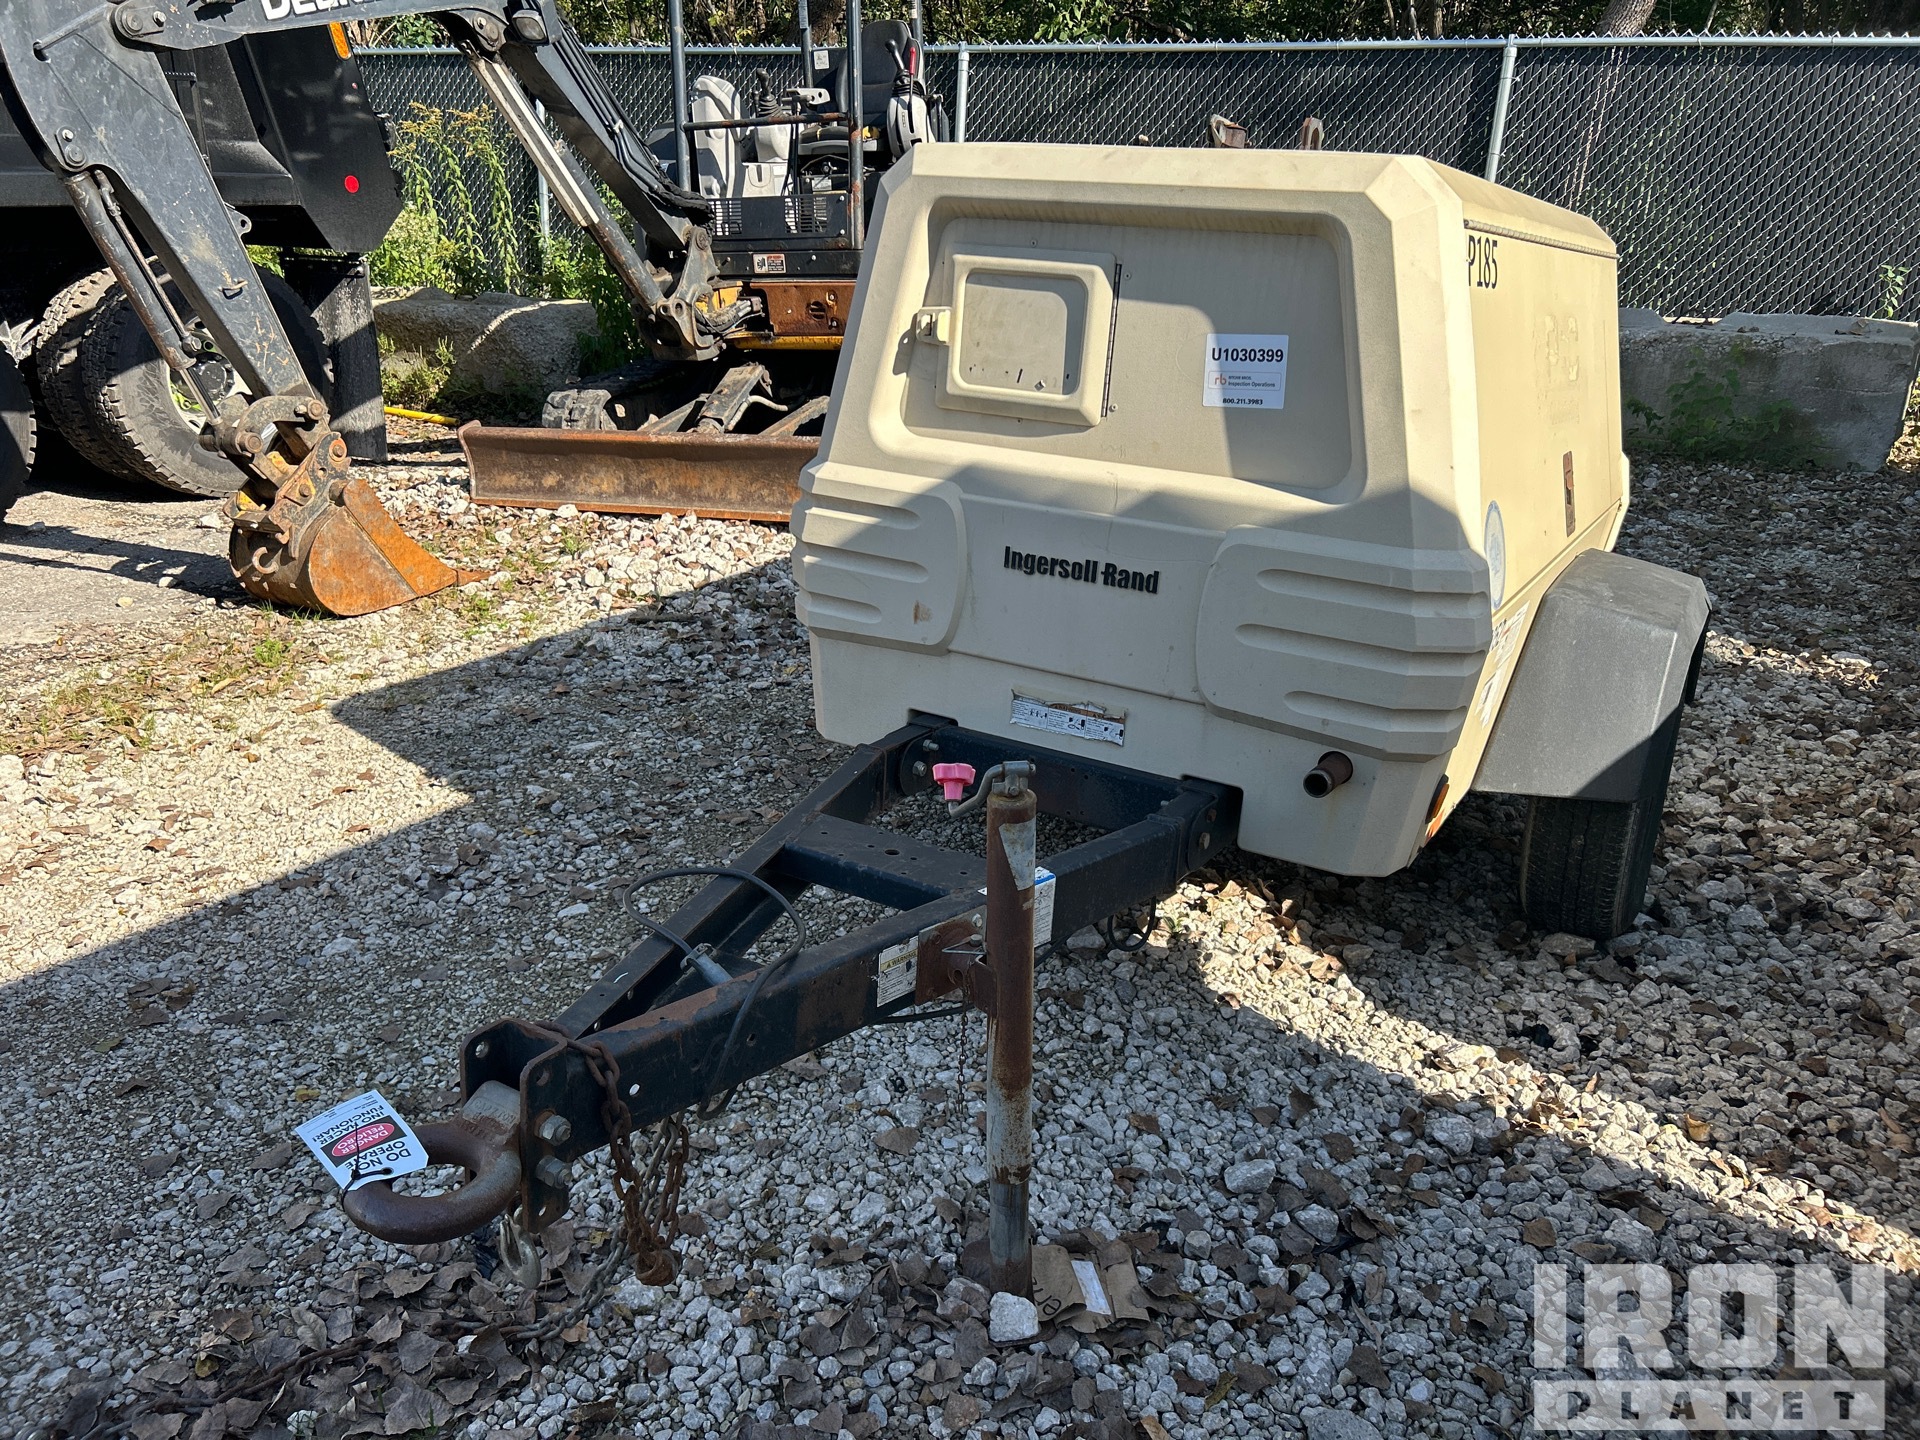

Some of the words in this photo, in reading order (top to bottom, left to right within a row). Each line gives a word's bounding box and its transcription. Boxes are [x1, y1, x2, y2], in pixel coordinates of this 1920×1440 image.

[1468, 235, 1498, 289] P185
[1212, 348, 1284, 362] U1030399
[1214, 373, 1226, 385] rb
[312, 1105, 384, 1142] FUNCIONAR!
[318, 1121, 360, 1145] HACER
[336, 1125, 384, 1149] PELIGRO
[340, 1130, 388, 1154] DANGER
[386, 1148, 412, 1162] DO
